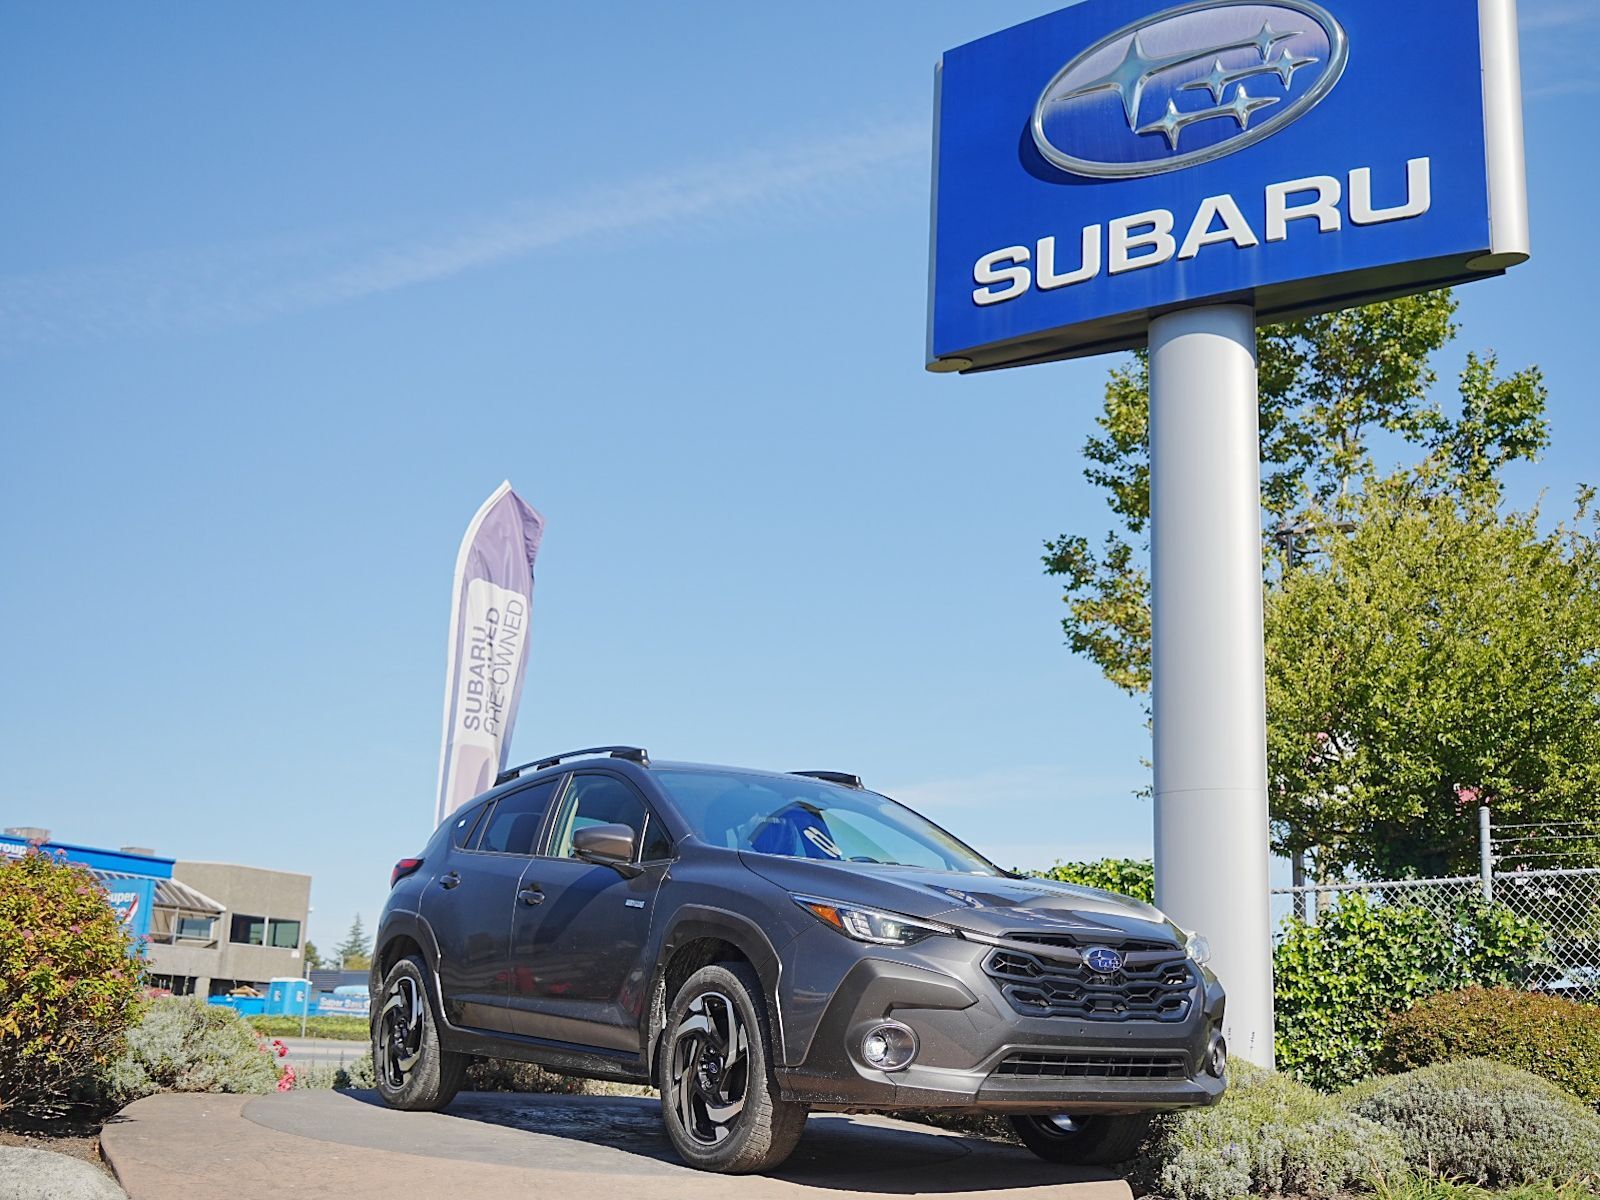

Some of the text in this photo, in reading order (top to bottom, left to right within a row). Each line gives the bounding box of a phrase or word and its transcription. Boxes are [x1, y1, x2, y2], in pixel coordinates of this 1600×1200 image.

[972, 157, 1431, 306] SUBARU
[463, 626, 487, 731] SUBARU
[106, 892, 136, 906] uper
